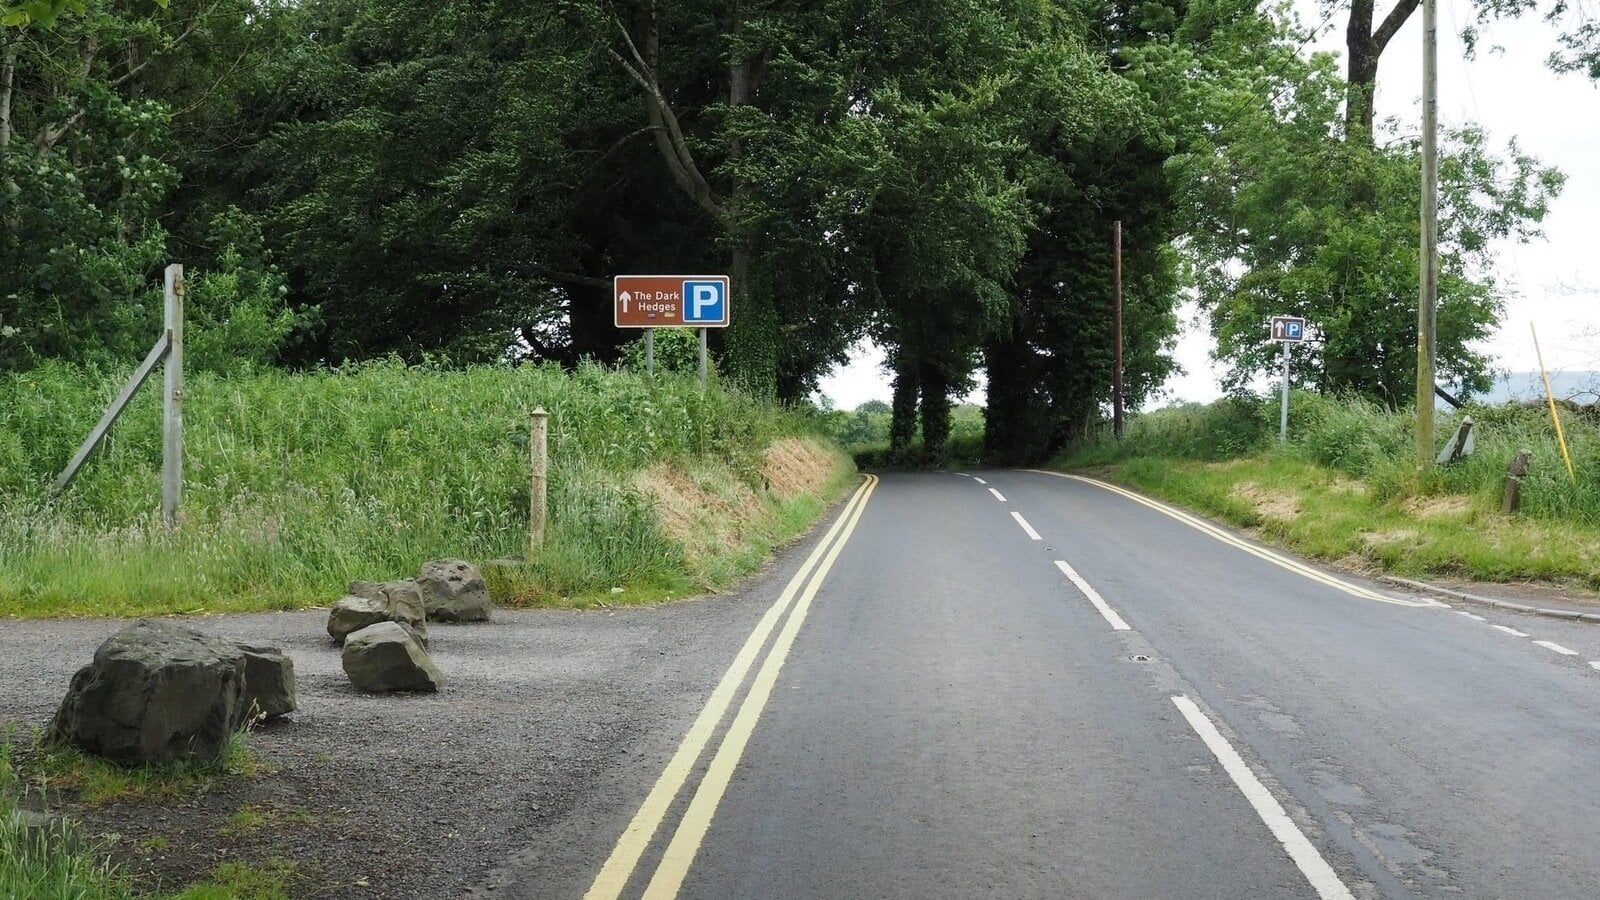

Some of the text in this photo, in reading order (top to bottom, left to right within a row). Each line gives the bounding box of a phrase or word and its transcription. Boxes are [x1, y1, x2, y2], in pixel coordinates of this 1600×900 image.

[634, 291, 680, 300] The Dark
[638, 302, 676, 312] Hedges
[693, 285, 719, 318] P
[1289, 323, 1299, 336] P
